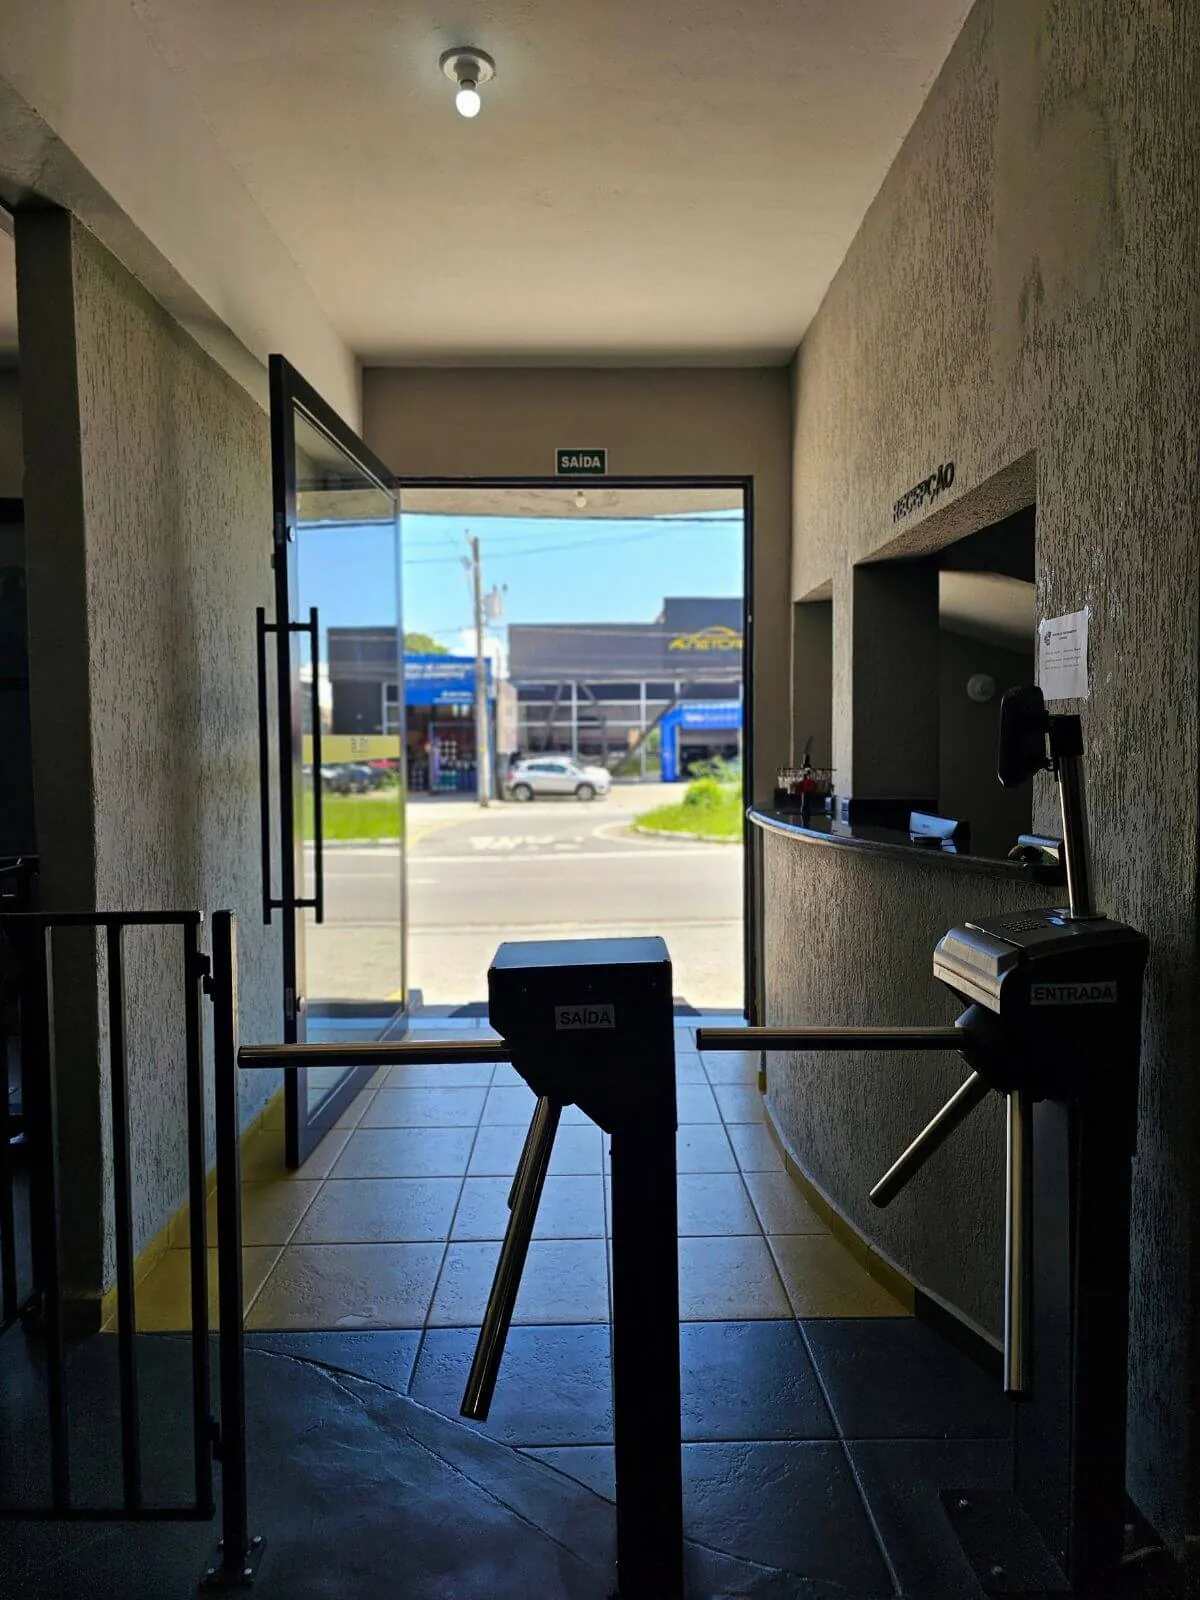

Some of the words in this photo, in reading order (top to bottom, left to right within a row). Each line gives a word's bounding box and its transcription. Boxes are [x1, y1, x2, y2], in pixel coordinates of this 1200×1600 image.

[561, 453, 601, 468] SAÍDA
[1034, 986, 1114, 1001] ENTRADA
[560, 1007, 612, 1025] SAÍDA
